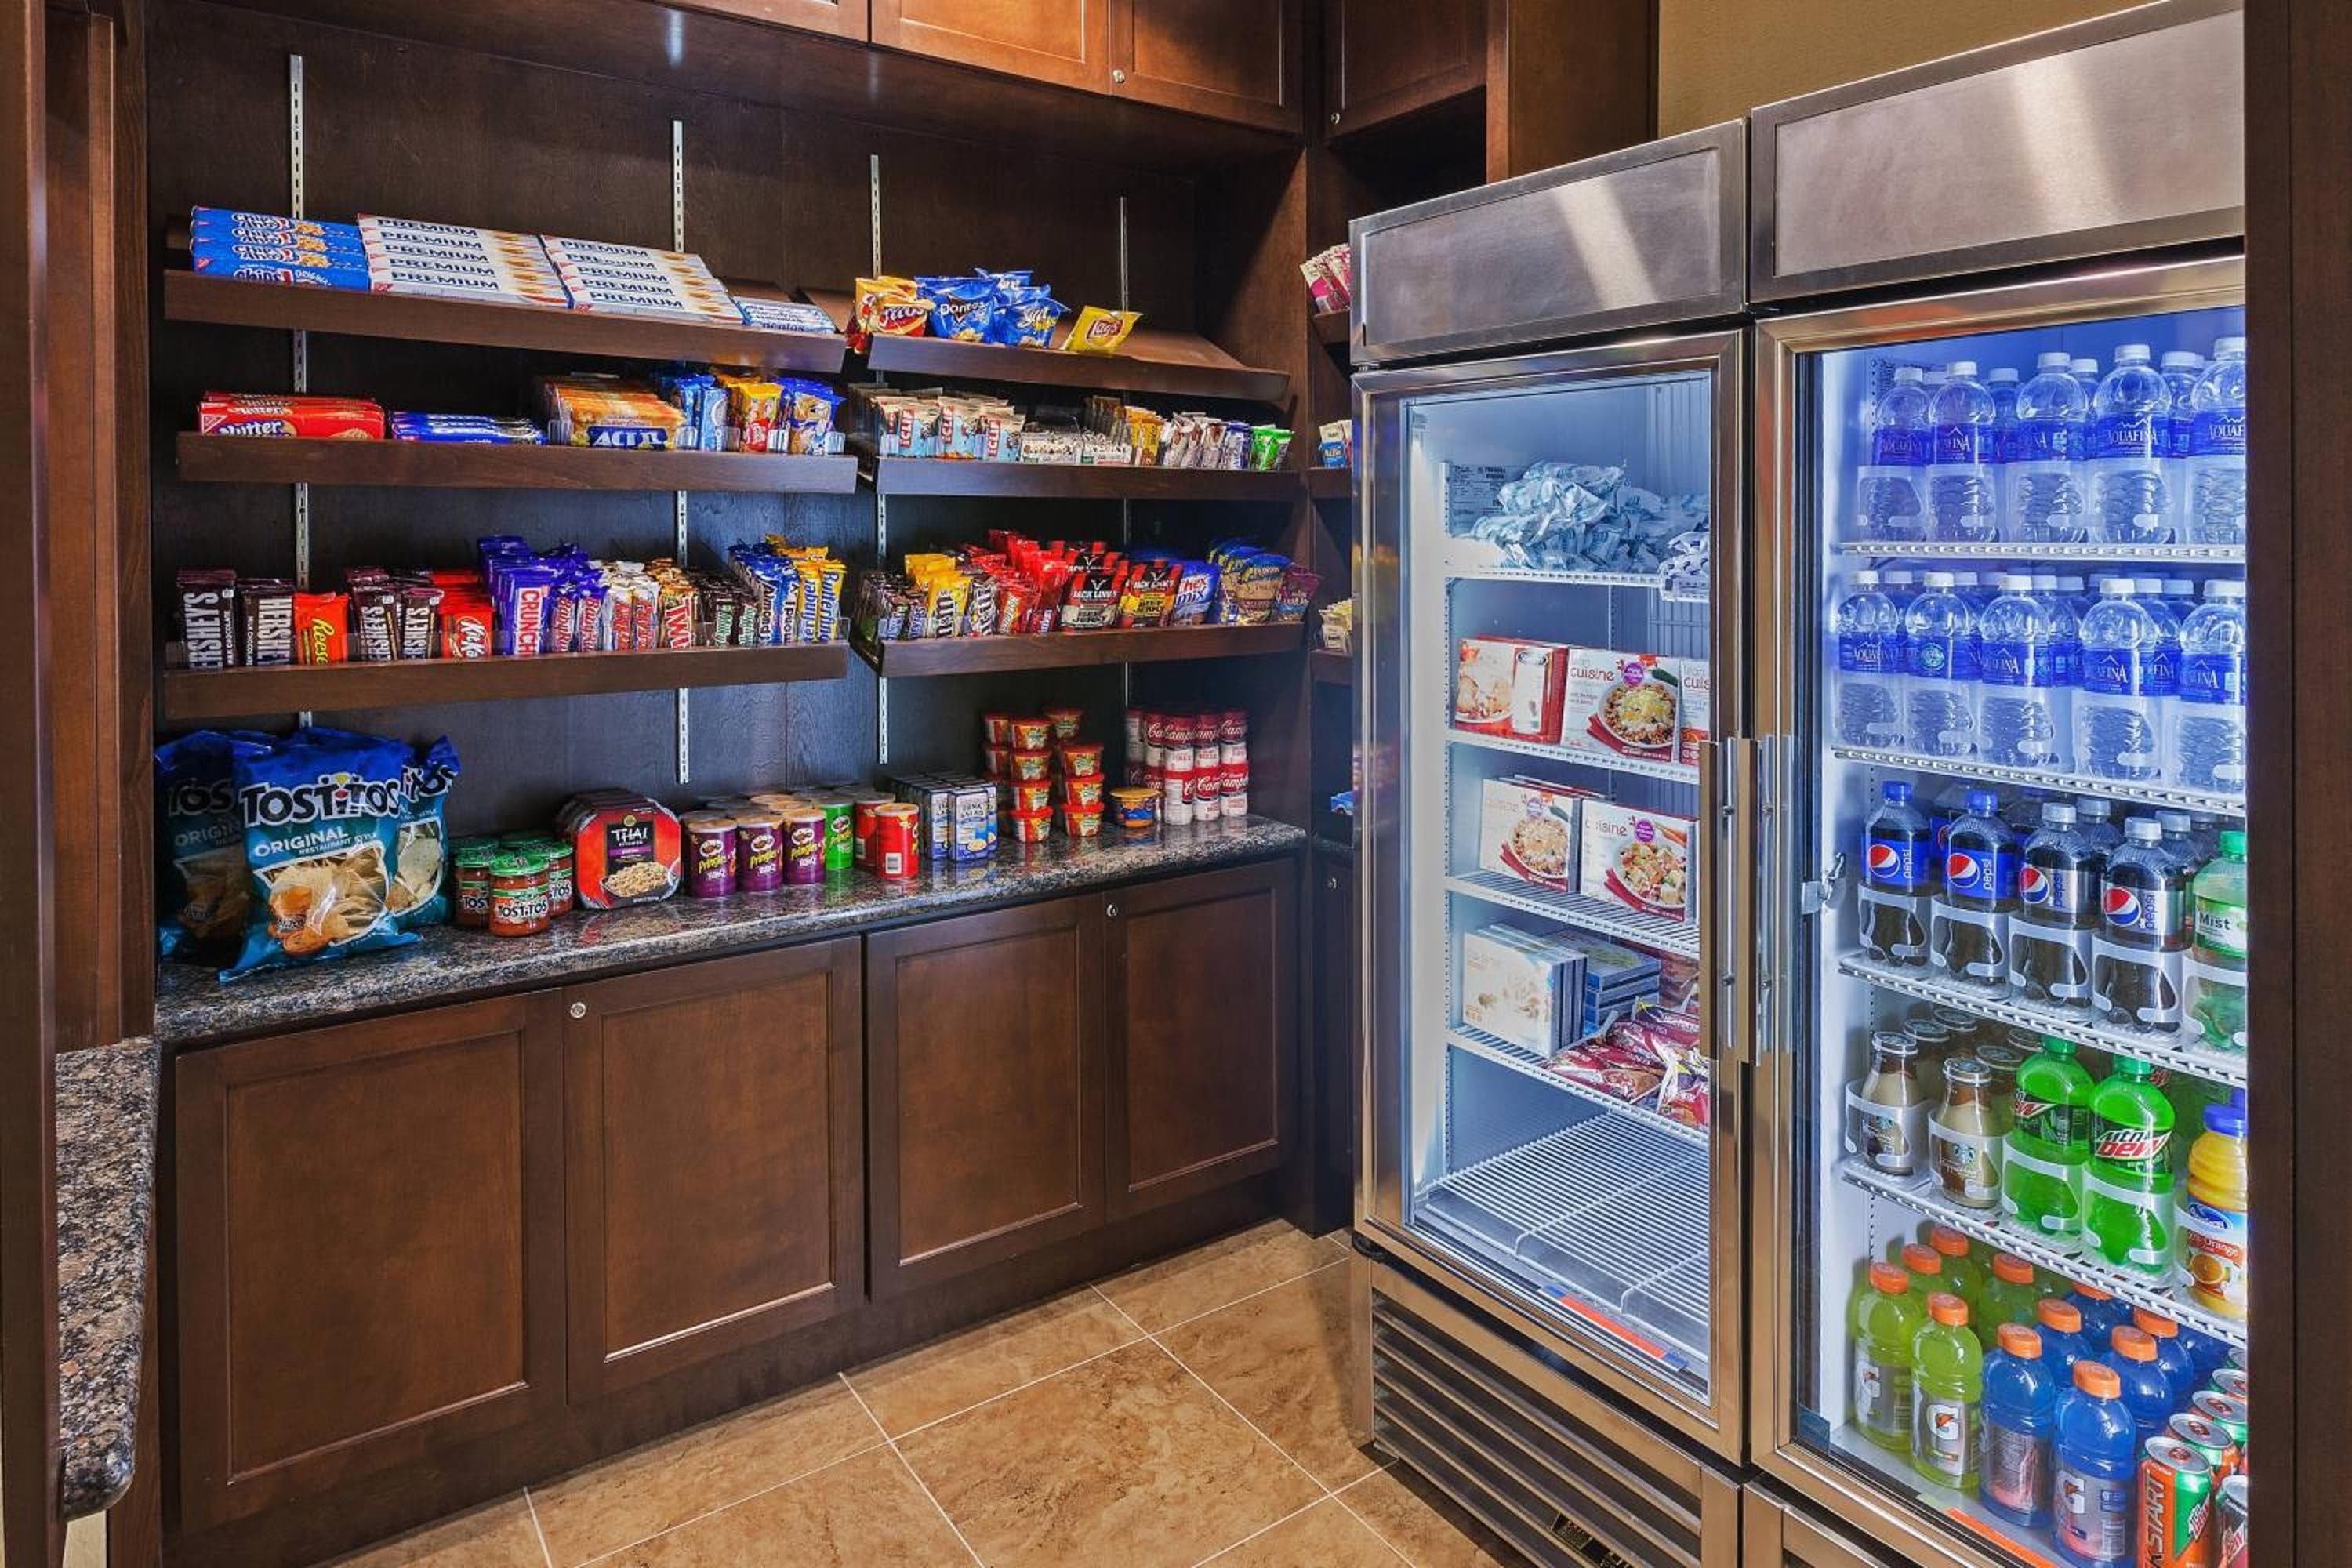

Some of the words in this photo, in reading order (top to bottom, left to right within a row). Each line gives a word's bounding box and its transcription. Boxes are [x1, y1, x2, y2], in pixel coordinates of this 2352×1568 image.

[377, 217, 478, 237] PREMIUM
[380, 230, 483, 250] PREMIUM
[560, 239, 650, 257] PREMIUM
[384, 243, 489, 263] PREMIUM
[389, 257, 495, 277] PREMIUM
[577, 265, 669, 282] PREMIUM
[392, 270, 499, 290] PREMIUM
[581, 278, 675, 296] PREMIUM
[589, 291, 684, 309] PREMIUM
[902, 408, 915, 441] CLIF
[2209, 423, 2245, 441] AQUAF
[760, 584, 777, 633] Almond
[820, 571, 840, 641] Butterfing
[183, 592, 223, 670] ERSHEY'S
[257, 597, 292, 666] HERSHE
[363, 606, 391, 661] ERSHEY'S
[518, 590, 540, 654] CRUNCH
[666, 597, 691, 648] TWI
[311, 617, 336, 666] Reese
[1570, 667, 1615, 681] cuisine
[1684, 677, 1710, 690] cuis
[254, 826, 349, 857] ORIGINAL
[611, 827, 648, 842] THAI
[1903, 849, 1913, 879] pepsi
[1981, 858, 1992, 891] pepsi
[2053, 871, 2063, 908] pepsi
[2144, 894, 2155, 930] pepsi
[2199, 912, 2230, 931] Mist
